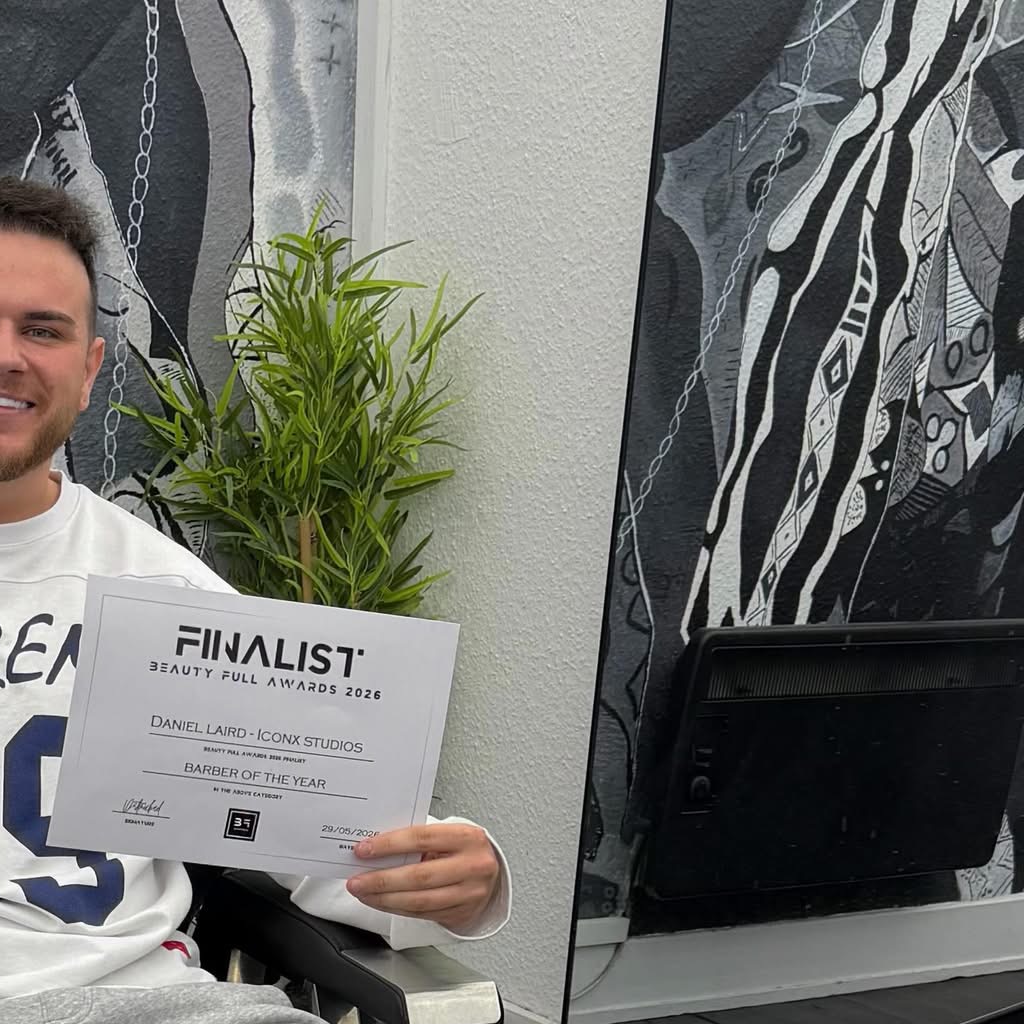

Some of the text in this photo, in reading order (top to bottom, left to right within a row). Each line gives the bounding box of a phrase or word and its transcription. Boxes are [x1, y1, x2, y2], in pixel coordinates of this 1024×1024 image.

[175, 624, 365, 679] FINALIST
[149, 661, 382, 701] BEAUTY FULL AWARDS 2026
[150, 714, 204, 734] DANIEL
[206, 723, 247, 739] LAIRD
[257, 728, 301, 746] ICONX
[303, 736, 364, 754] STUDIOS
[184, 762, 327, 790] BARBER OF THE YEAR
